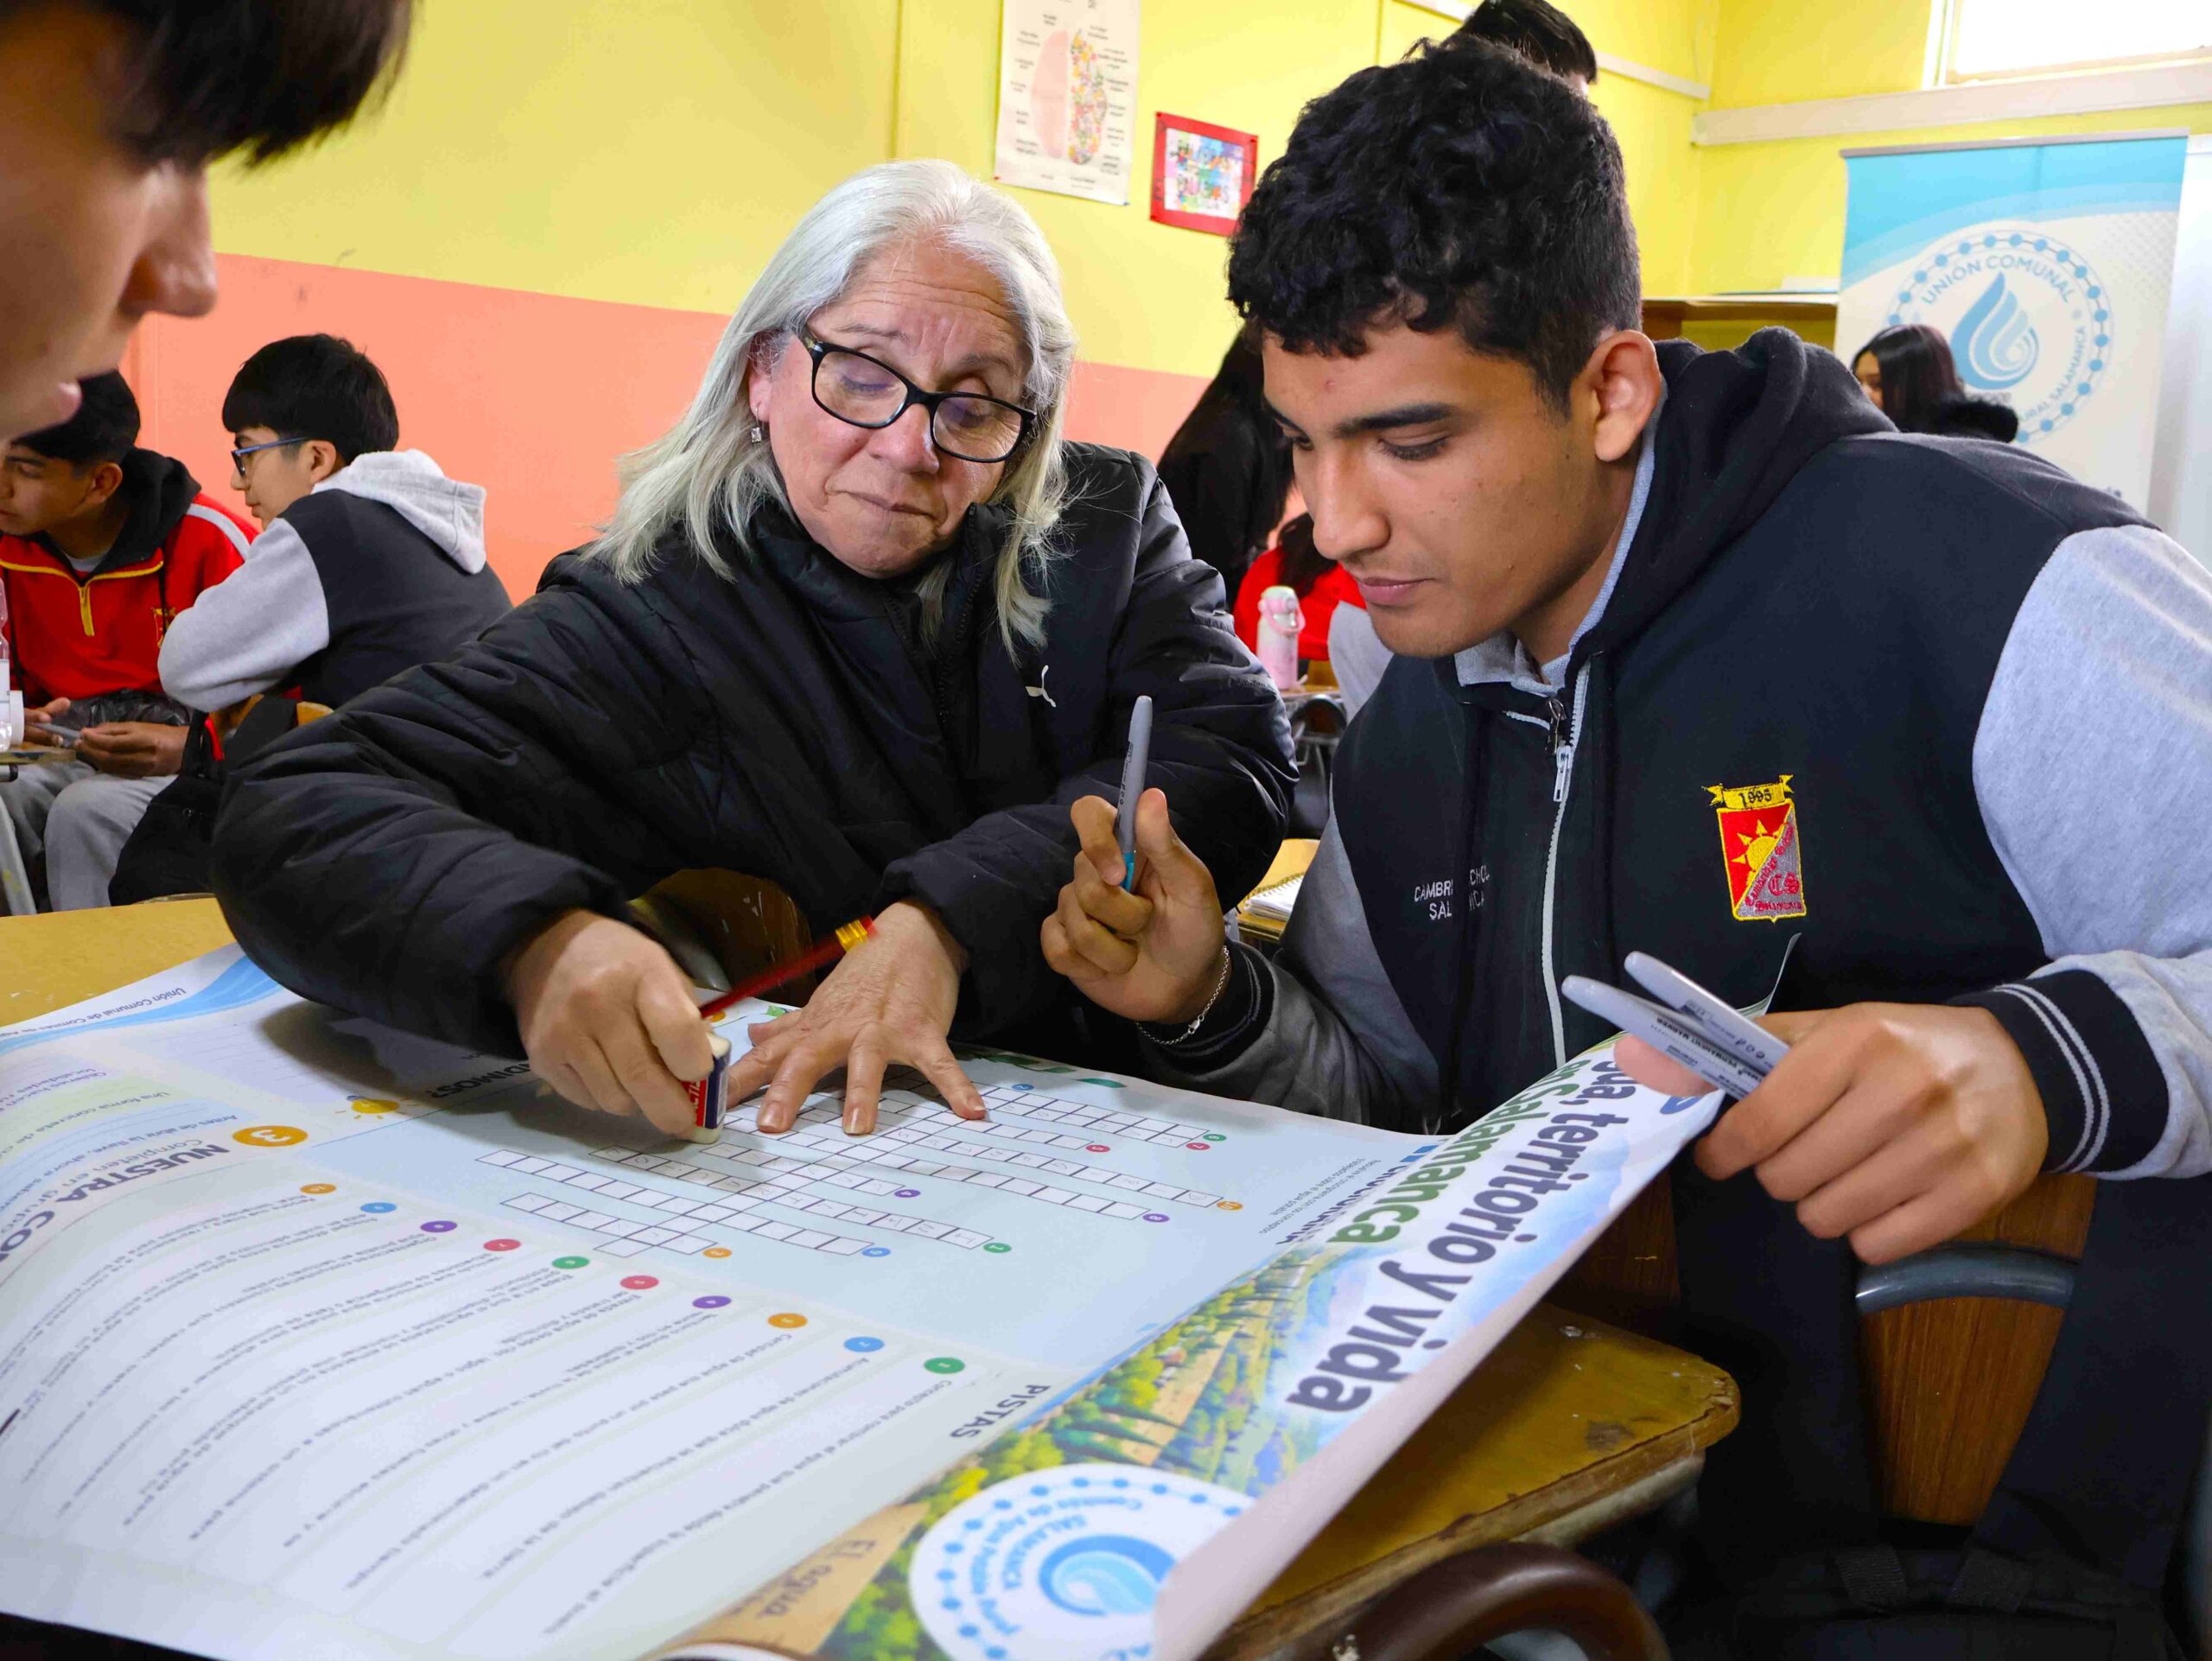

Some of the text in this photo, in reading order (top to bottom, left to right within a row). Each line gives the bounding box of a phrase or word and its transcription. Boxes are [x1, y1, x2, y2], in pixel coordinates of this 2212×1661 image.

[1987, 254, 2075, 302] COMUNAL
[1739, 789, 1771, 807] 1995
[102, 997, 153, 1015] Comunal
[92, 1135, 202, 1174] Completen
[248, 1128, 292, 1144] 3
[56, 1143, 231, 1204] NUESTRA
[1325, 1084, 1580, 1244] Salamanca
[1427, 1113, 1630, 1266] territorio
[1378, 1258, 1474, 1303] y
[1286, 1302, 1448, 1413] vida
[949, 1384, 1052, 1439] PISTAS
[753, 1564, 833, 1620] agua
